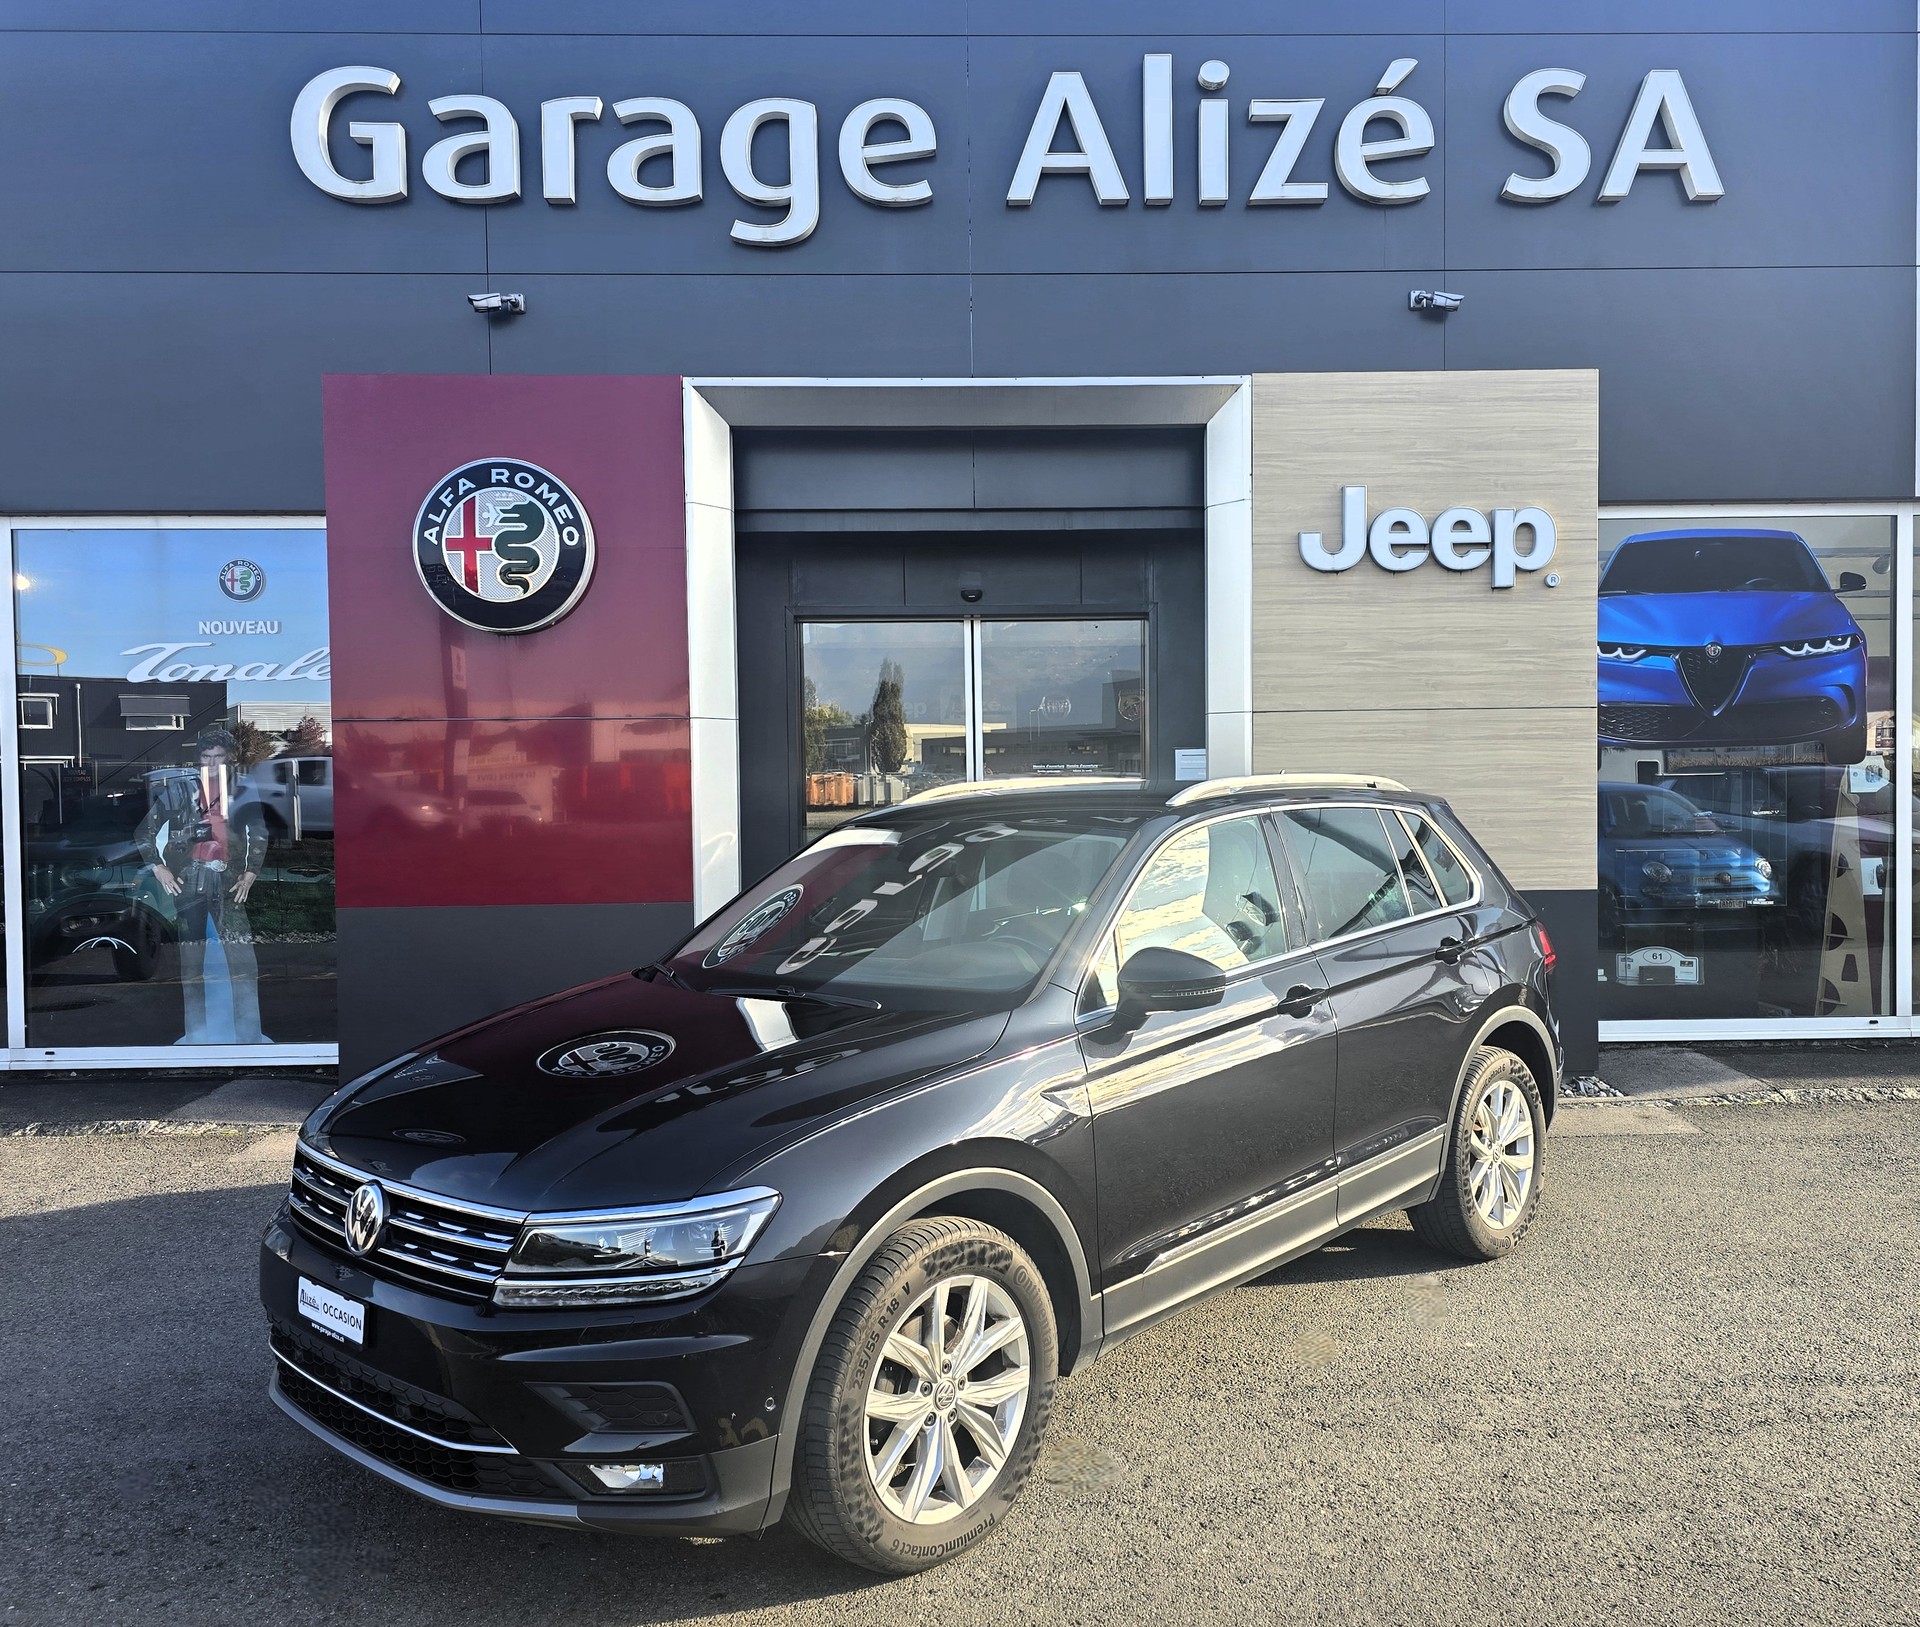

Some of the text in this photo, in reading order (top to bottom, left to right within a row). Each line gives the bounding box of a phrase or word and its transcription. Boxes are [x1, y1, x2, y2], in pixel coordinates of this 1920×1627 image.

[290, 53, 1726, 247] Garage Alizé SA
[423, 468, 580, 546] ALFA ROMEO
[1298, 484, 1558, 589] Jeep
[220, 560, 261, 581] ALFA ROMEO
[199, 620, 281, 635] NOUVEAU
[119, 642, 331, 683] Tonale
[1651, 952, 1663, 960] 61
[322, 1302, 362, 1331] OCCASION
[853, 1281, 911, 1390] 235/55 R 18 V
[889, 1512, 996, 1559] PremiumContact 6
